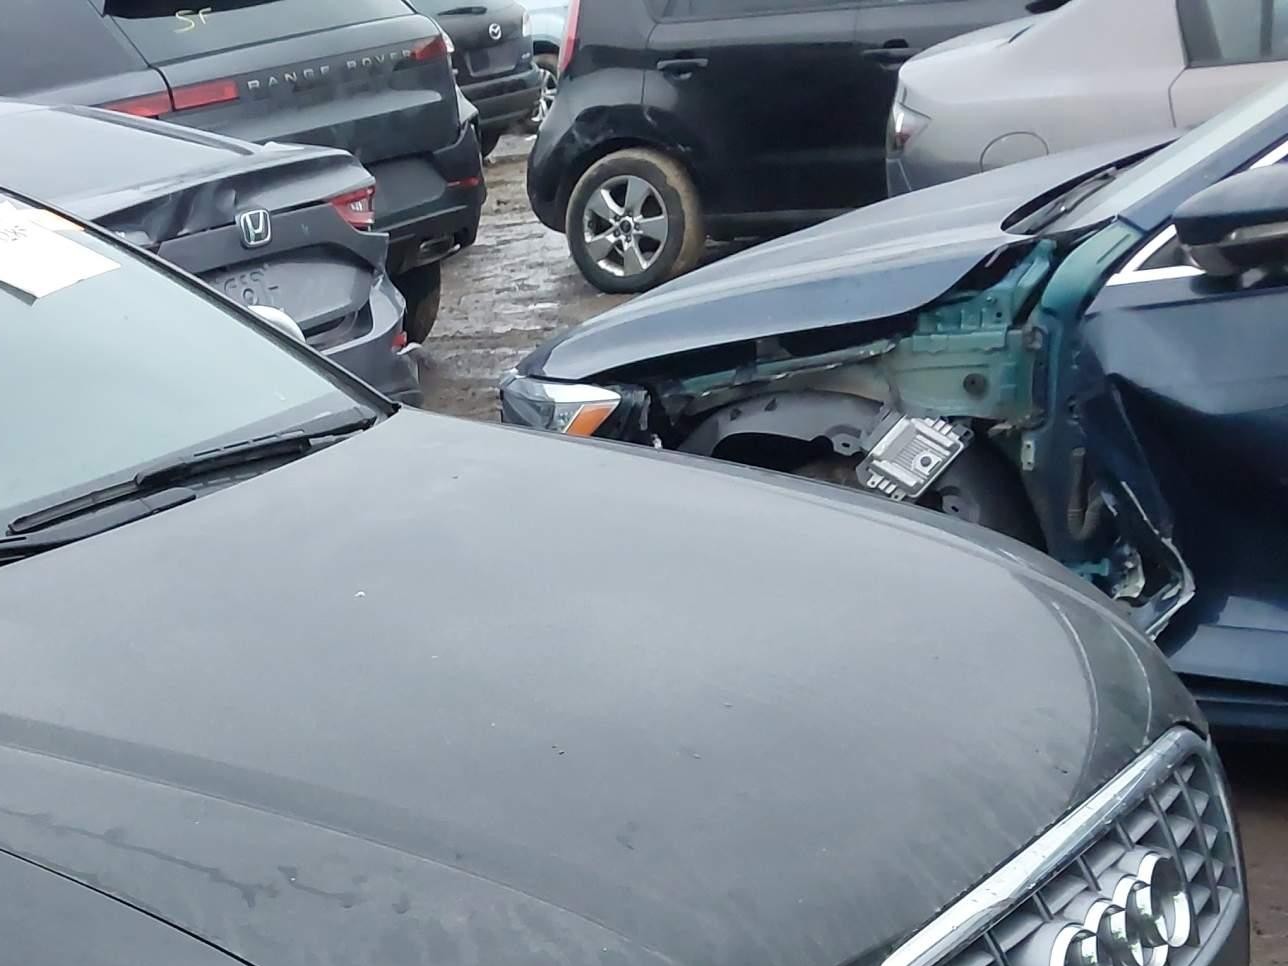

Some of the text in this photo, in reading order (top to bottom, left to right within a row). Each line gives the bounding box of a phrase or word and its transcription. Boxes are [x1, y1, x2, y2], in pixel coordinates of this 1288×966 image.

[173, 7, 212, 33] SF
[247, 49, 412, 91] RANGE ROVER
